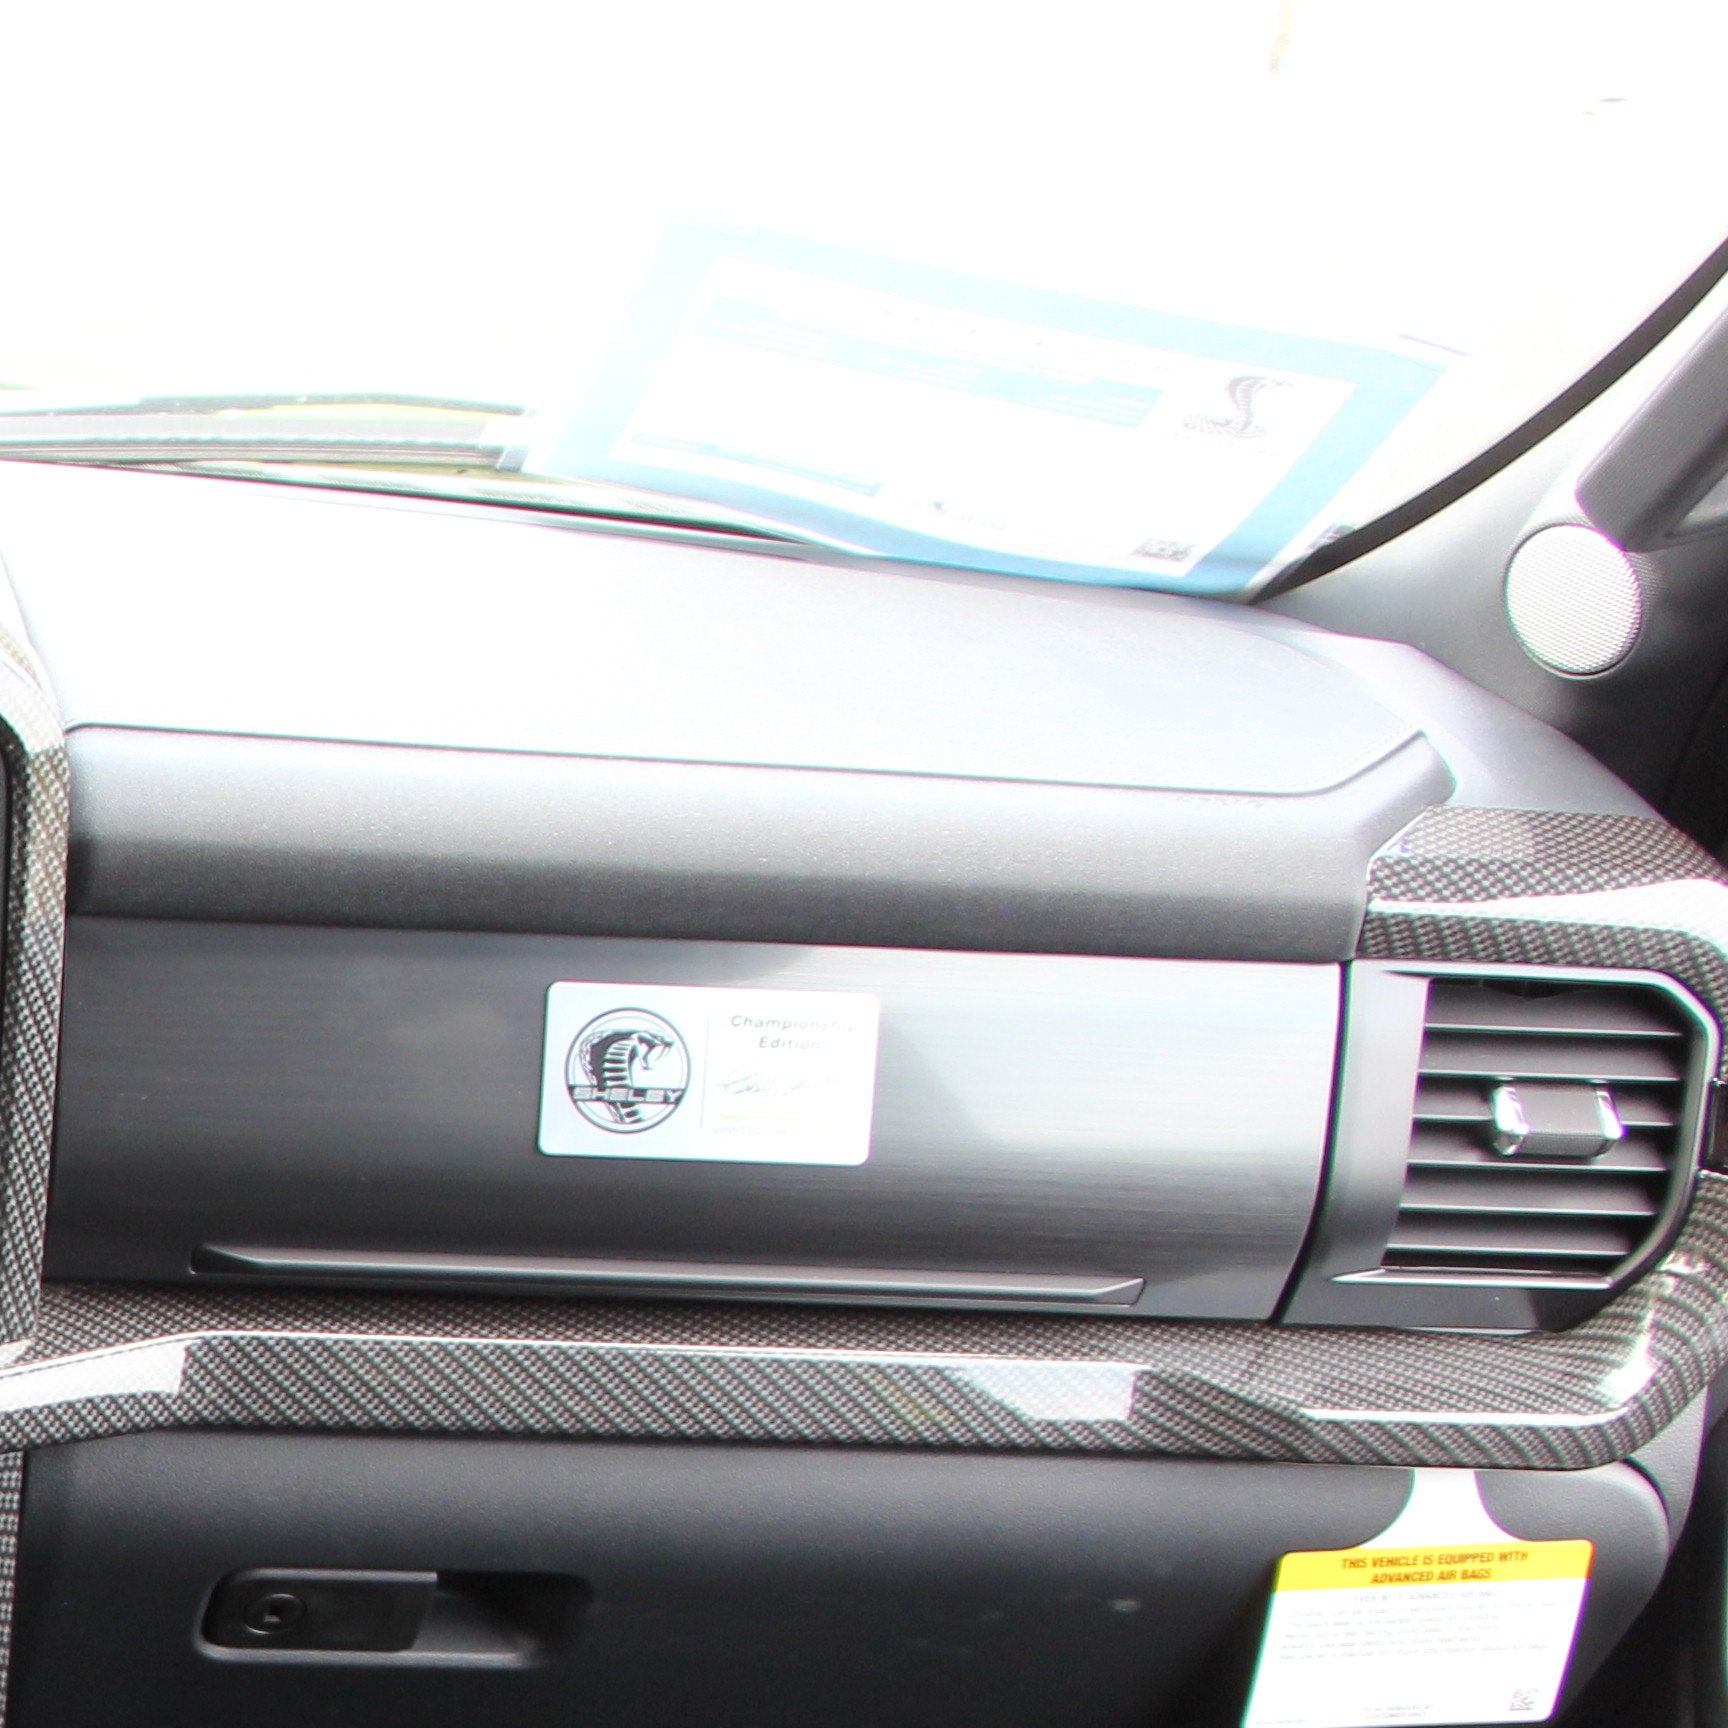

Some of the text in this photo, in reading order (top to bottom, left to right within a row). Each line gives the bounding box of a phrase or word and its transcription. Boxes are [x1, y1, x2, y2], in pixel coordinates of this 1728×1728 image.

[758, 1036, 821, 1049] Edition
[1341, 1550, 1529, 1570] THIS VEHICLE IS EQUIPPED WITH
[1370, 1568, 1492, 1584] ADVANCED AIR BAGS
